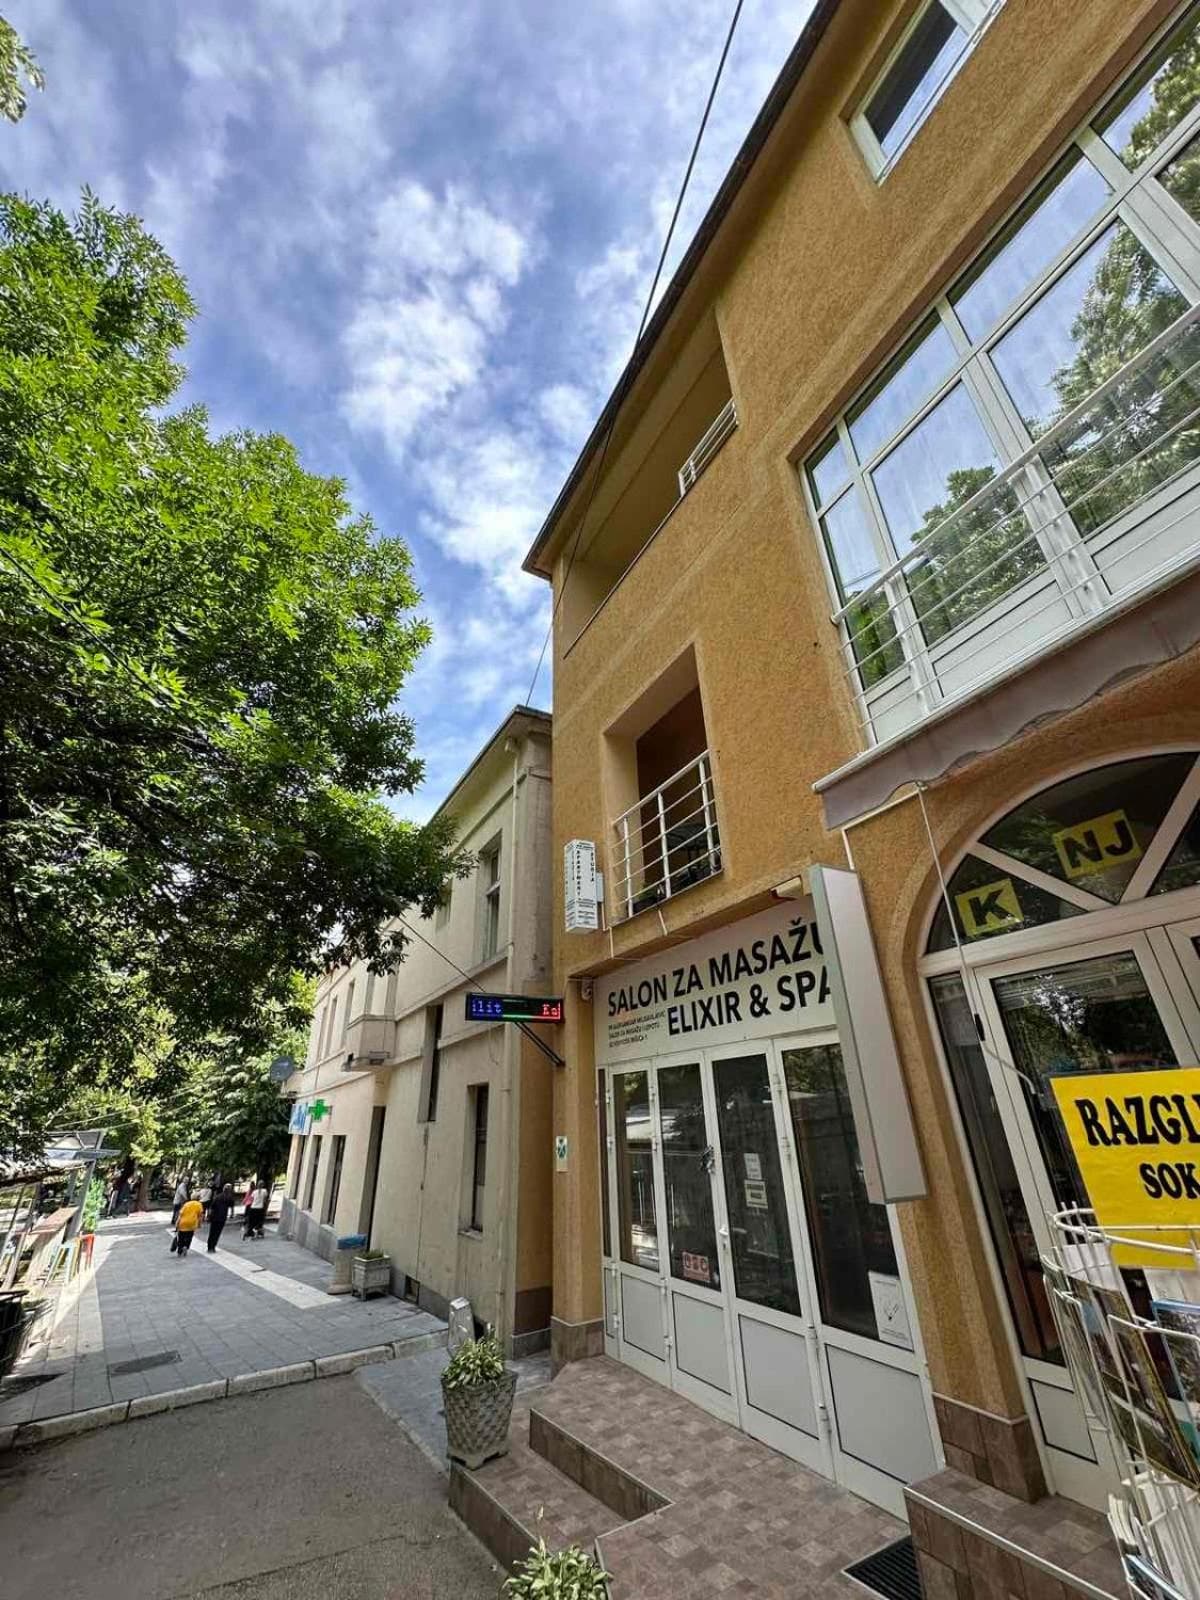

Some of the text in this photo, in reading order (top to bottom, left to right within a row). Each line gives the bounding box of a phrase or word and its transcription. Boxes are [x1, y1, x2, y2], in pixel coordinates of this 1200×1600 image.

[1063, 819, 1134, 869] NJ
[969, 888, 1015, 927] K
[608, 974, 668, 1016] SALON
[672, 967, 704, 997] ZA
[667, 991, 743, 1035] ELIXIR
[749, 983, 771, 1018] &
[1075, 1094, 1200, 1146] RAZGL
